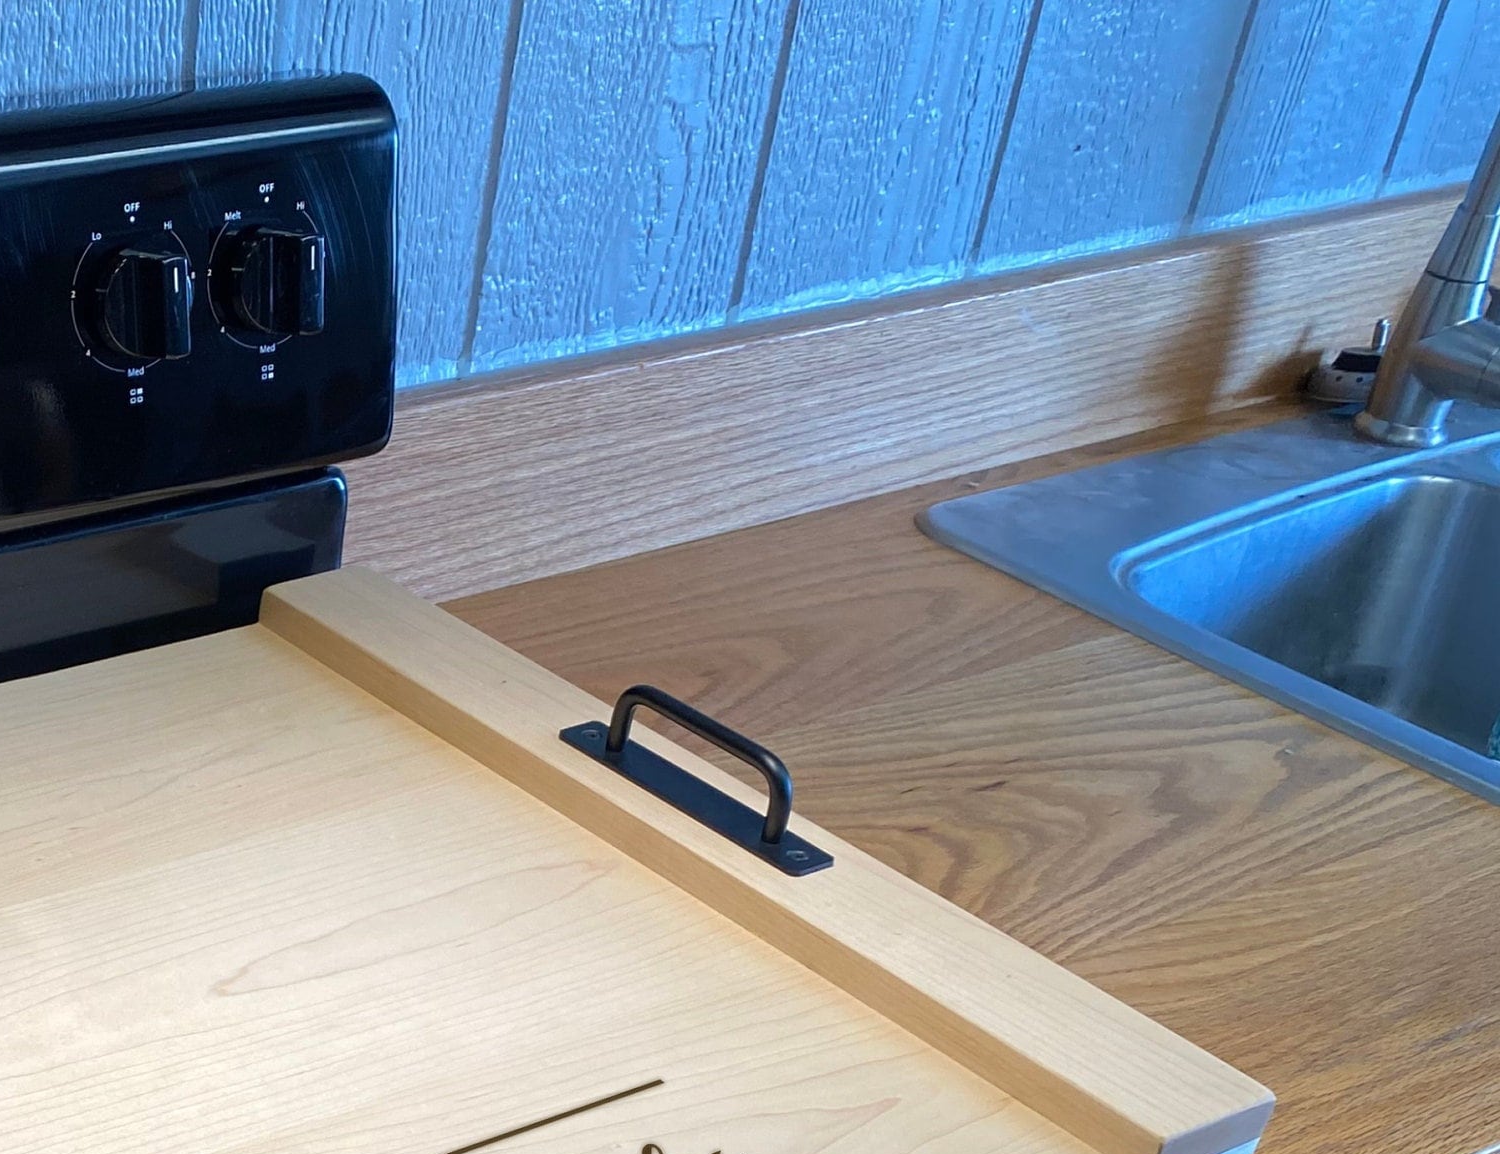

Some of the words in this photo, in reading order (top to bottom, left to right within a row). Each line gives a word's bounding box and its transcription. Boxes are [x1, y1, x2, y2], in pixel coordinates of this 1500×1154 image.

[259, 183, 274, 193] OFF
[124, 202, 140, 213] OFF
[296, 201, 305, 210] Hi
[224, 211, 241, 221] Melt
[164, 221, 172, 230] Hi
[92, 232, 102, 241] Lo
[206, 268, 213, 277] 2
[71, 290, 75, 298] 2
[86, 349, 90, 357] 4
[260, 344, 275, 353] Med
[128, 367, 144, 376] Med
